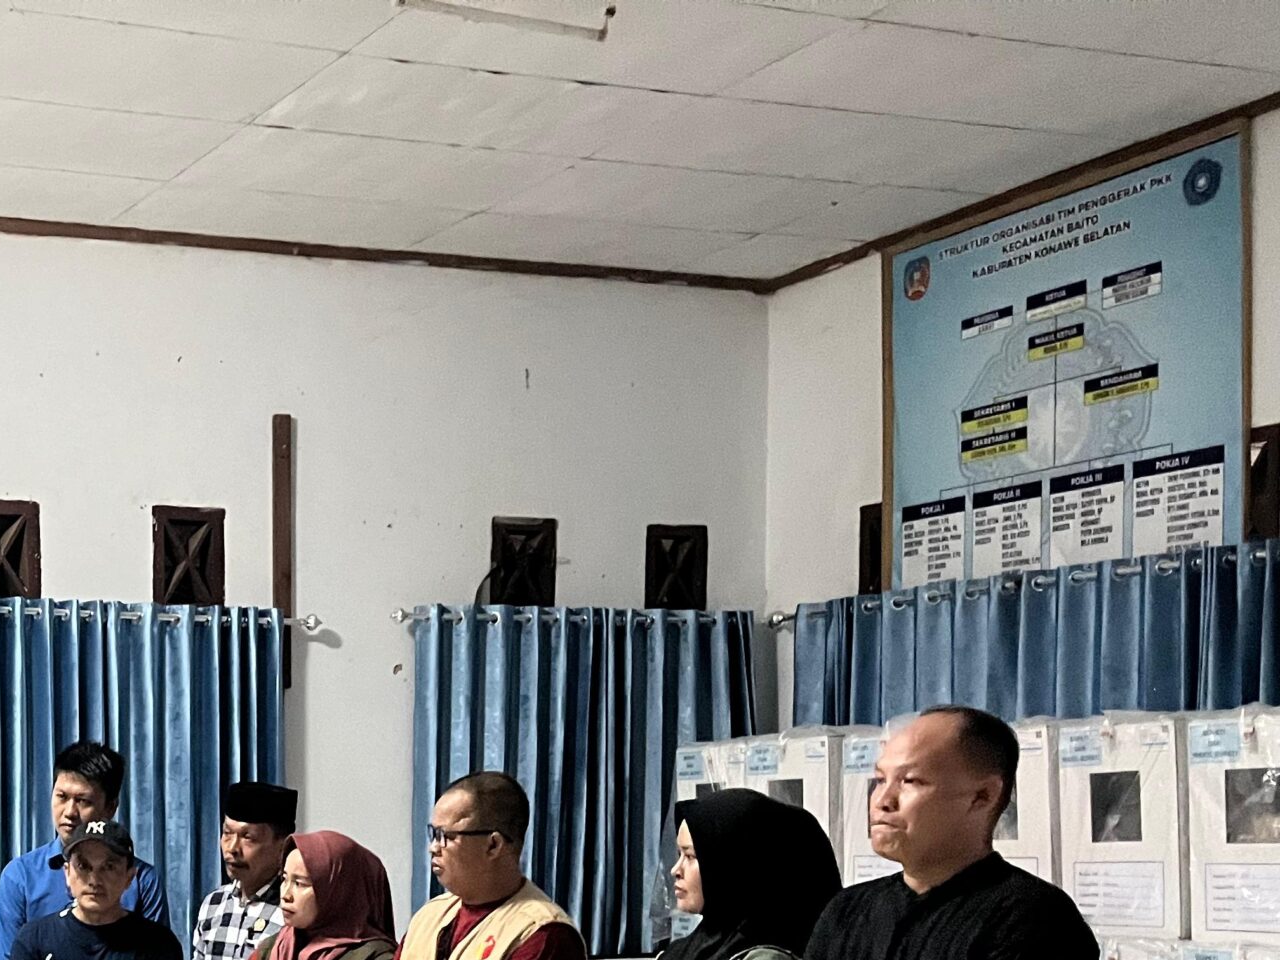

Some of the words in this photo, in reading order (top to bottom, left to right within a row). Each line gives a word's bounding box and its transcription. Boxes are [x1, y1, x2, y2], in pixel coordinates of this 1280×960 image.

[938, 236, 990, 260] STRUKTUR
[1058, 206, 1076, 220] TIM
[1078, 181, 1146, 213] PENGGERAK
[1150, 173, 1172, 190] PKK
[1002, 226, 1064, 254] KECAMATAN
[1067, 214, 1099, 234] BAITO
[972, 252, 1032, 279] KABUPATEN
[1034, 236, 1080, 258] KONAWE
[1083, 220, 1131, 244] SELATAN
[1071, 474, 1093, 486] POKJA
[1155, 457, 1180, 470] POKJA
[1181, 456, 1190, 465] IV
